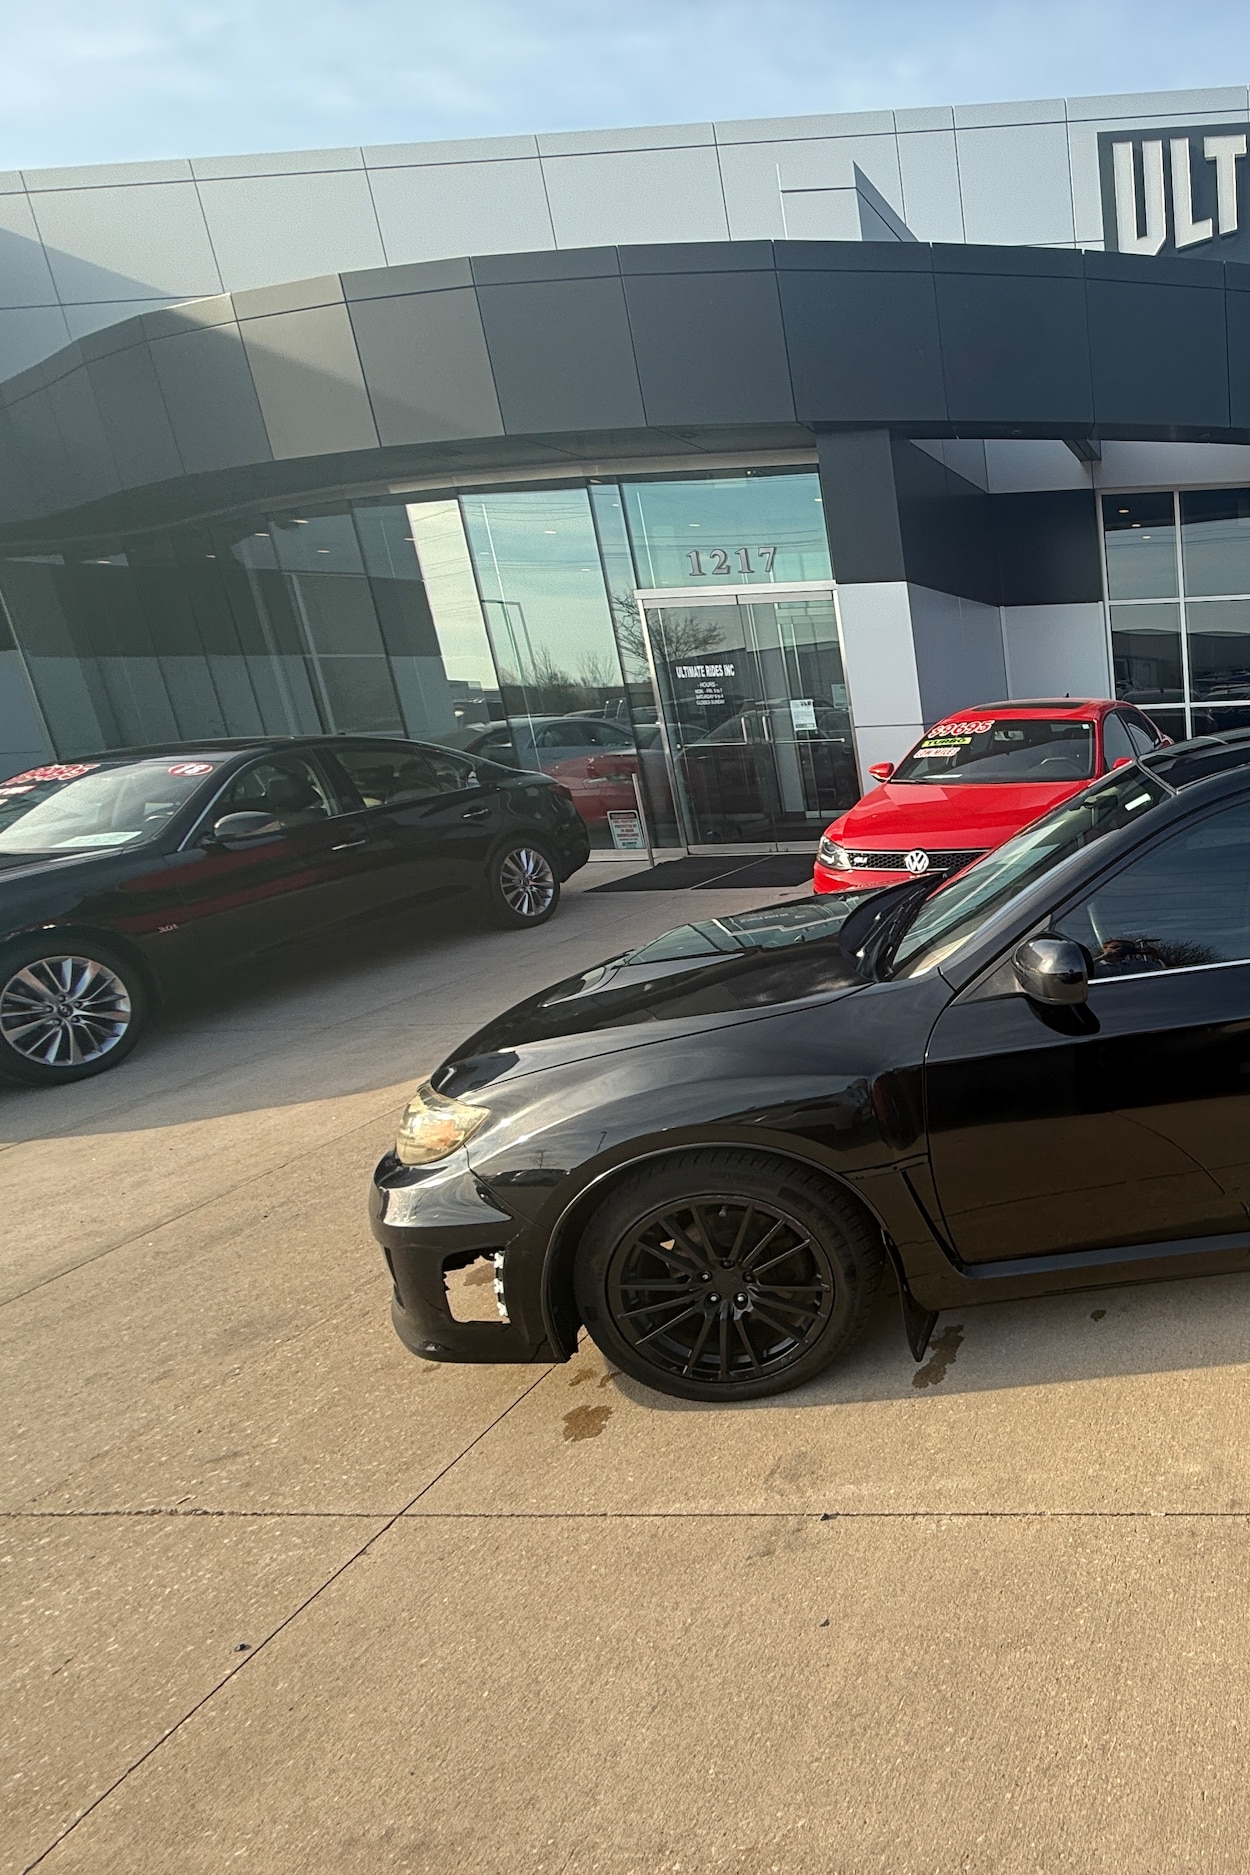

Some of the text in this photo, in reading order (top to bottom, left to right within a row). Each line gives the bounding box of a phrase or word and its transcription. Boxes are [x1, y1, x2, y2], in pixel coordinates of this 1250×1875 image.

[685, 546, 777, 576] 1217
[675, 663, 735, 679] ULTIMATE RIDES INC
[928, 720, 995, 739] $9695
